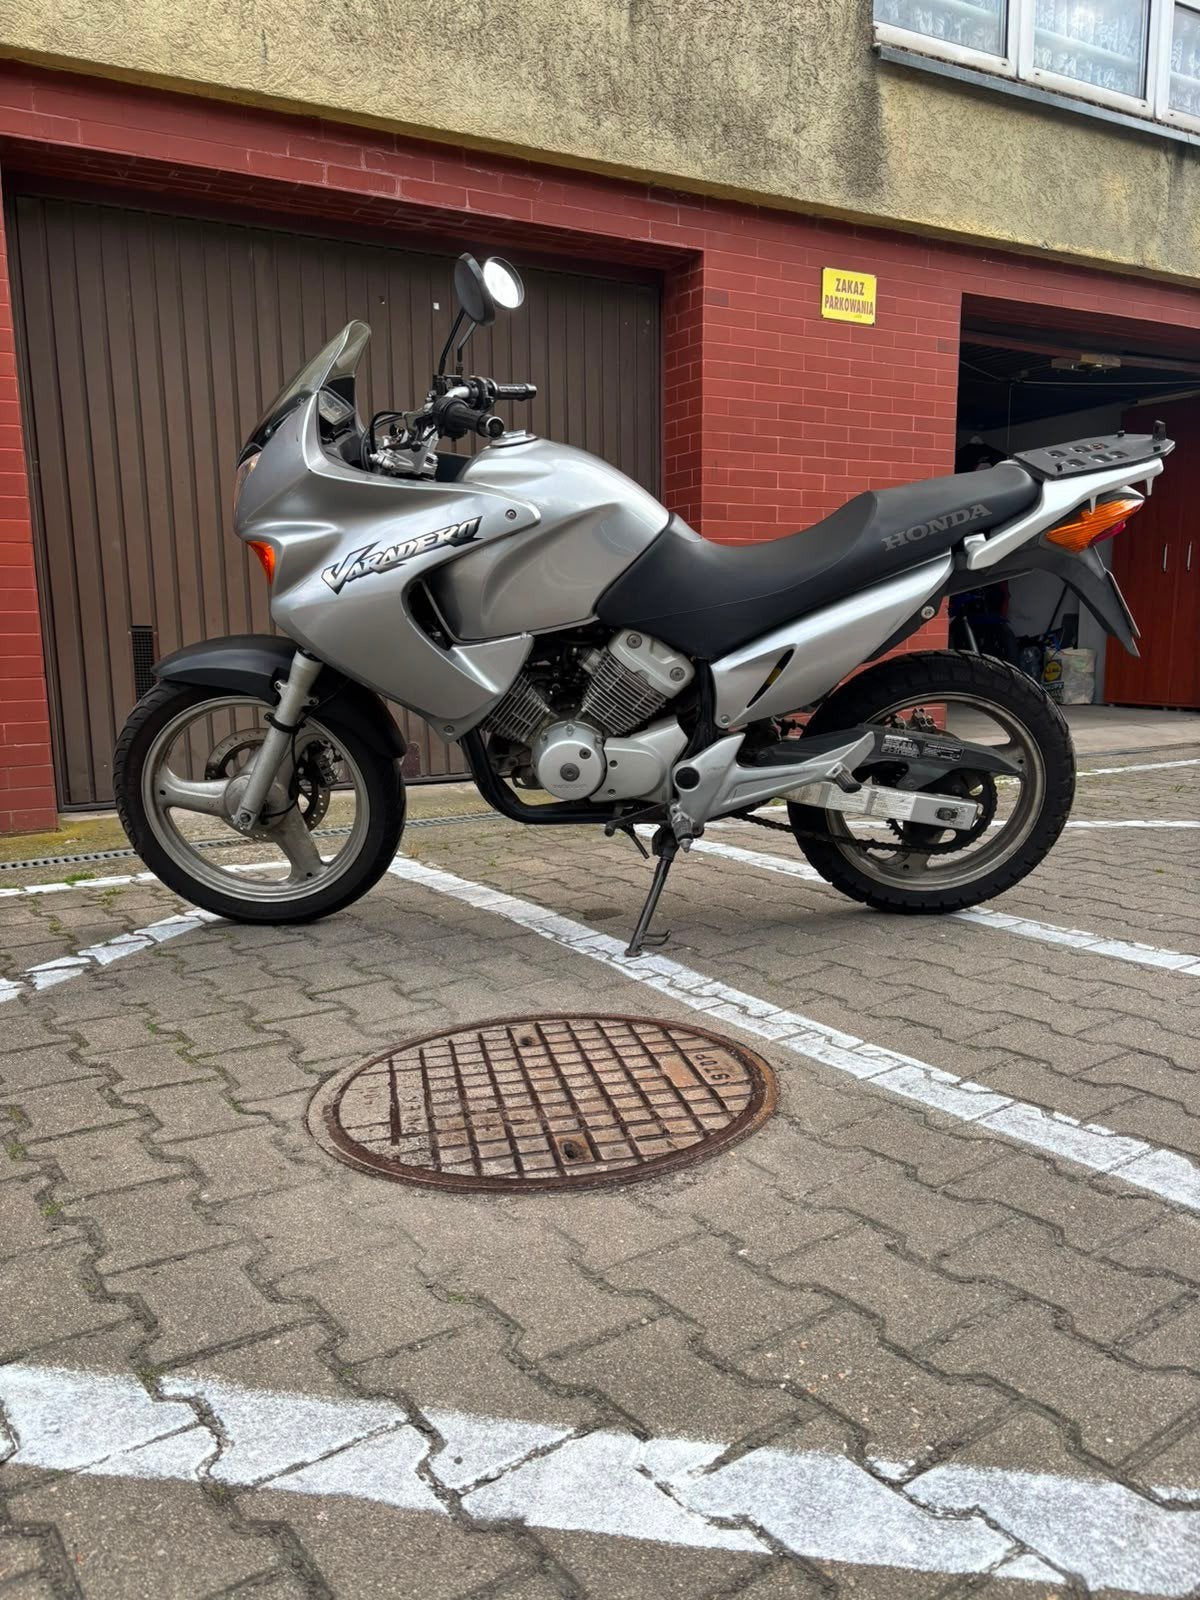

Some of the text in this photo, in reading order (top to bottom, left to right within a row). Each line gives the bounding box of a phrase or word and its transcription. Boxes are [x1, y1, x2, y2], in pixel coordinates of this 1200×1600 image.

[835, 278, 865, 296] ZAKAZ
[824, 295, 874, 316] PARKOWANIA
[881, 504, 992, 551] HONDA
[321, 516, 485, 595] VARADERO
